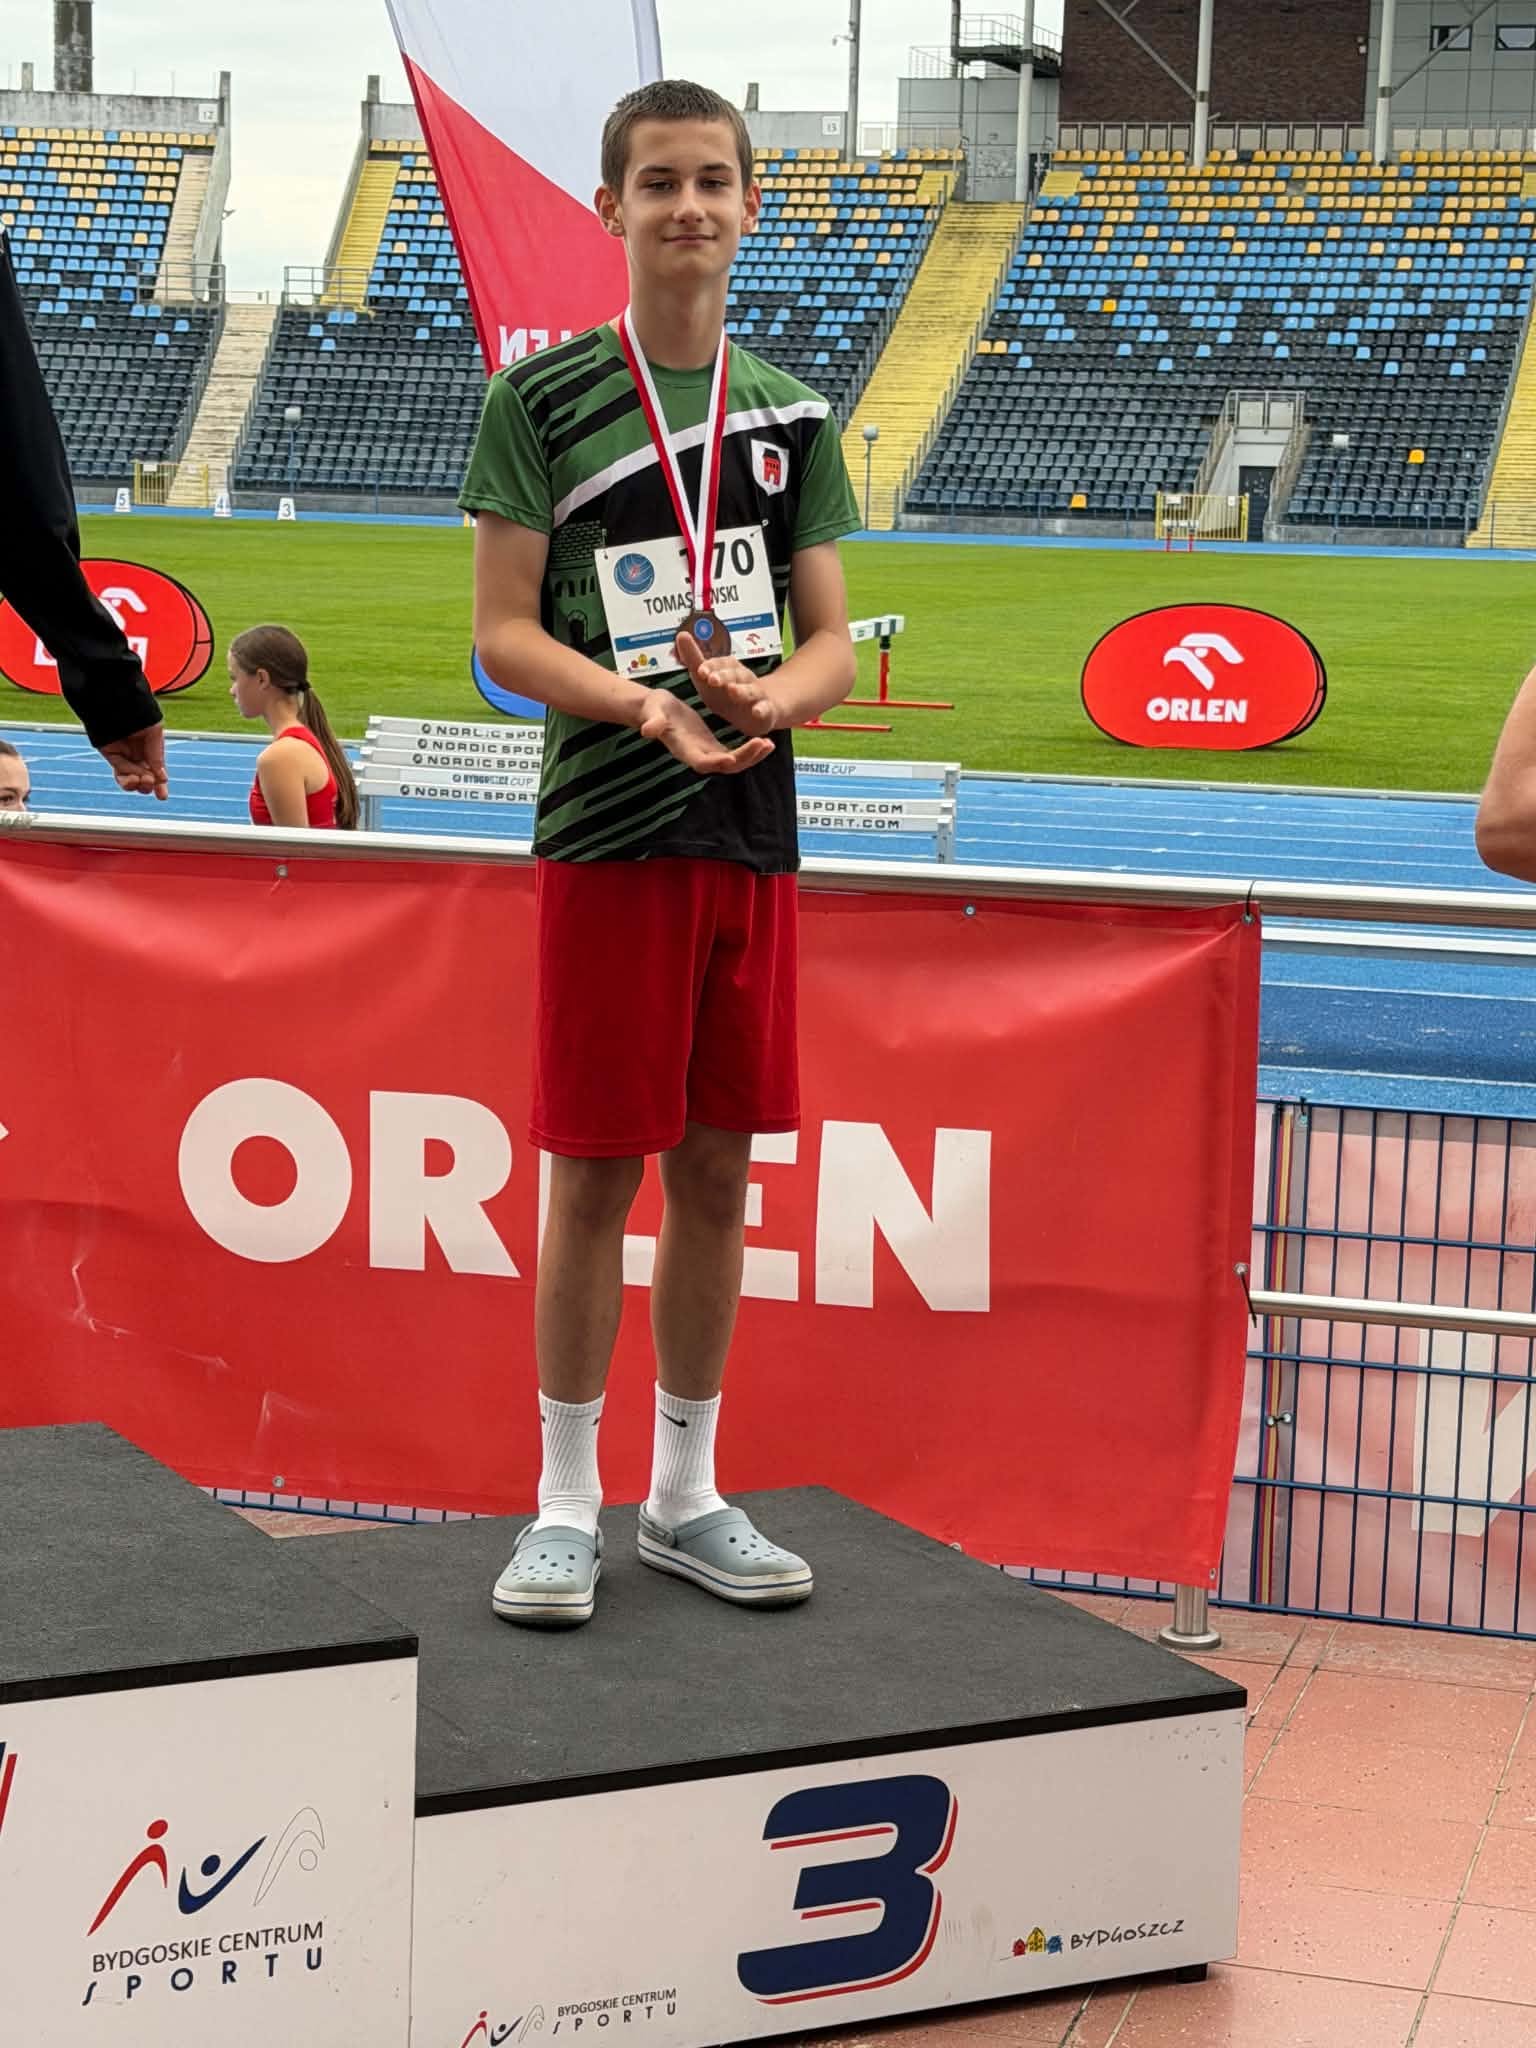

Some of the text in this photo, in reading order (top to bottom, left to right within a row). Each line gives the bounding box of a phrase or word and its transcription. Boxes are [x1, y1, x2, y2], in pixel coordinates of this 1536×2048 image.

[679, 538, 754, 584] 70
[1146, 697, 1248, 723] ORLEN
[432, 741, 545, 755] NORDIC SPOR
[427, 755, 541, 770] NORDIC SPOR
[831, 765, 857, 775] CUP
[415, 786, 538, 801] NORDIC SPORT
[510, 778, 534, 788] CUP
[801, 801, 903, 814] SPORT.COM
[797, 816, 900, 829] SPORT.COM
[737, 1774, 959, 2006] 3
[92, 1920, 324, 1974] BYDGOSKIE CENTRUM
[1069, 1919, 1185, 1952] BYDGOSZCZ
[81, 1947, 323, 2007] SPORTU
[558, 1988, 677, 2017] BYDGOSKIE CENTRUM
[553, 2003, 677, 2034] SPORTU
